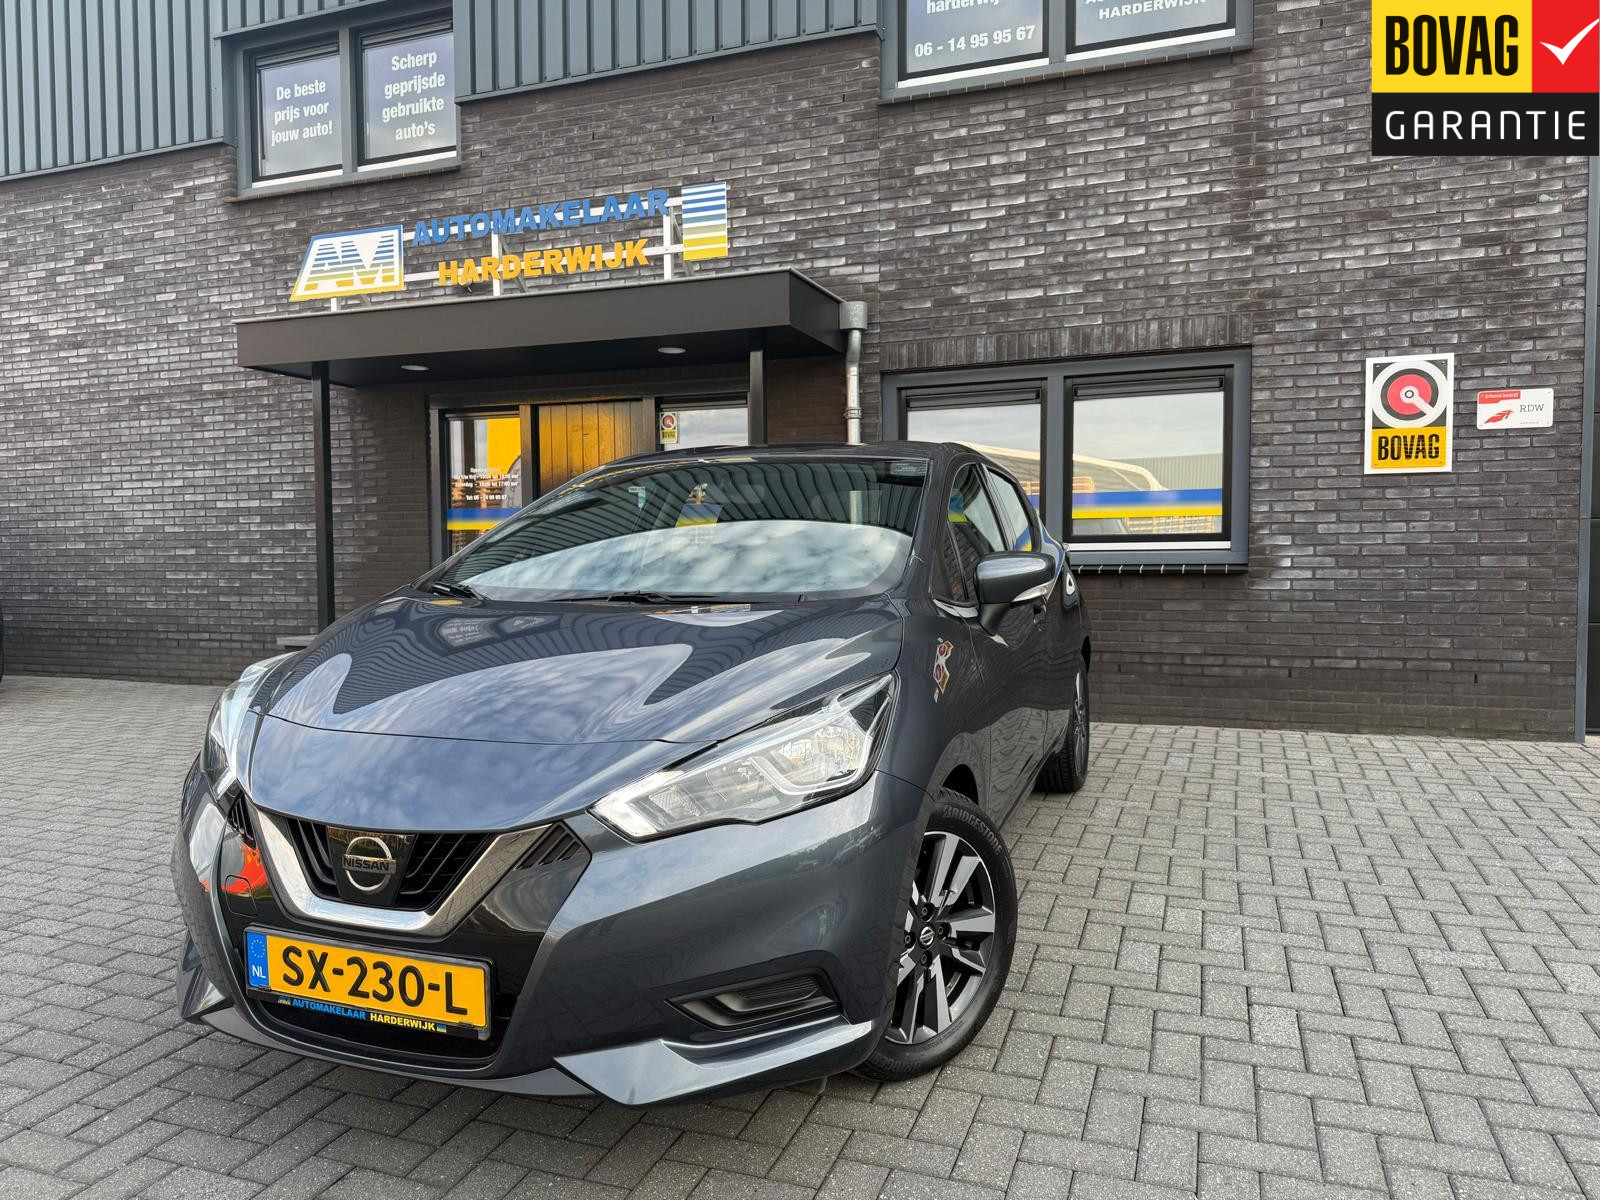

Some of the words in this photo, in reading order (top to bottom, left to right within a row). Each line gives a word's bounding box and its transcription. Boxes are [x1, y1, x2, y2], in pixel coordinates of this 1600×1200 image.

[914, 42, 933, 57] 06
[948, 36, 966, 52] 14
[970, 32, 989, 48] 95
[993, 28, 1012, 45] 95
[1016, 25, 1036, 41] 67
[391, 52, 437, 71] Scherp
[276, 86, 291, 100] De
[294, 79, 326, 97] beste
[384, 73, 445, 99] geprijsde
[274, 108, 300, 125] prijs
[303, 101, 329, 117] voor
[382, 97, 445, 123] gebruikte
[271, 127, 299, 147] jouw
[302, 120, 333, 138] auto!
[395, 121, 436, 141] auto's
[412, 188, 669, 248] AUTOMAKELAAR
[438, 238, 649, 286] HARDERWIJK
[1519, 403, 1545, 413] RDW
[1377, 433, 1440, 460] BOVAG
[942, 804, 1003, 856] BRIDGESTONE
[343, 857, 389, 871] NISSAN
[251, 964, 267, 979] NL
[281, 945, 468, 1016] SX-230-L
[292, 998, 366, 1020] AUTOMAKELAAR
[369, 1012, 436, 1032] HARDERWIJK
